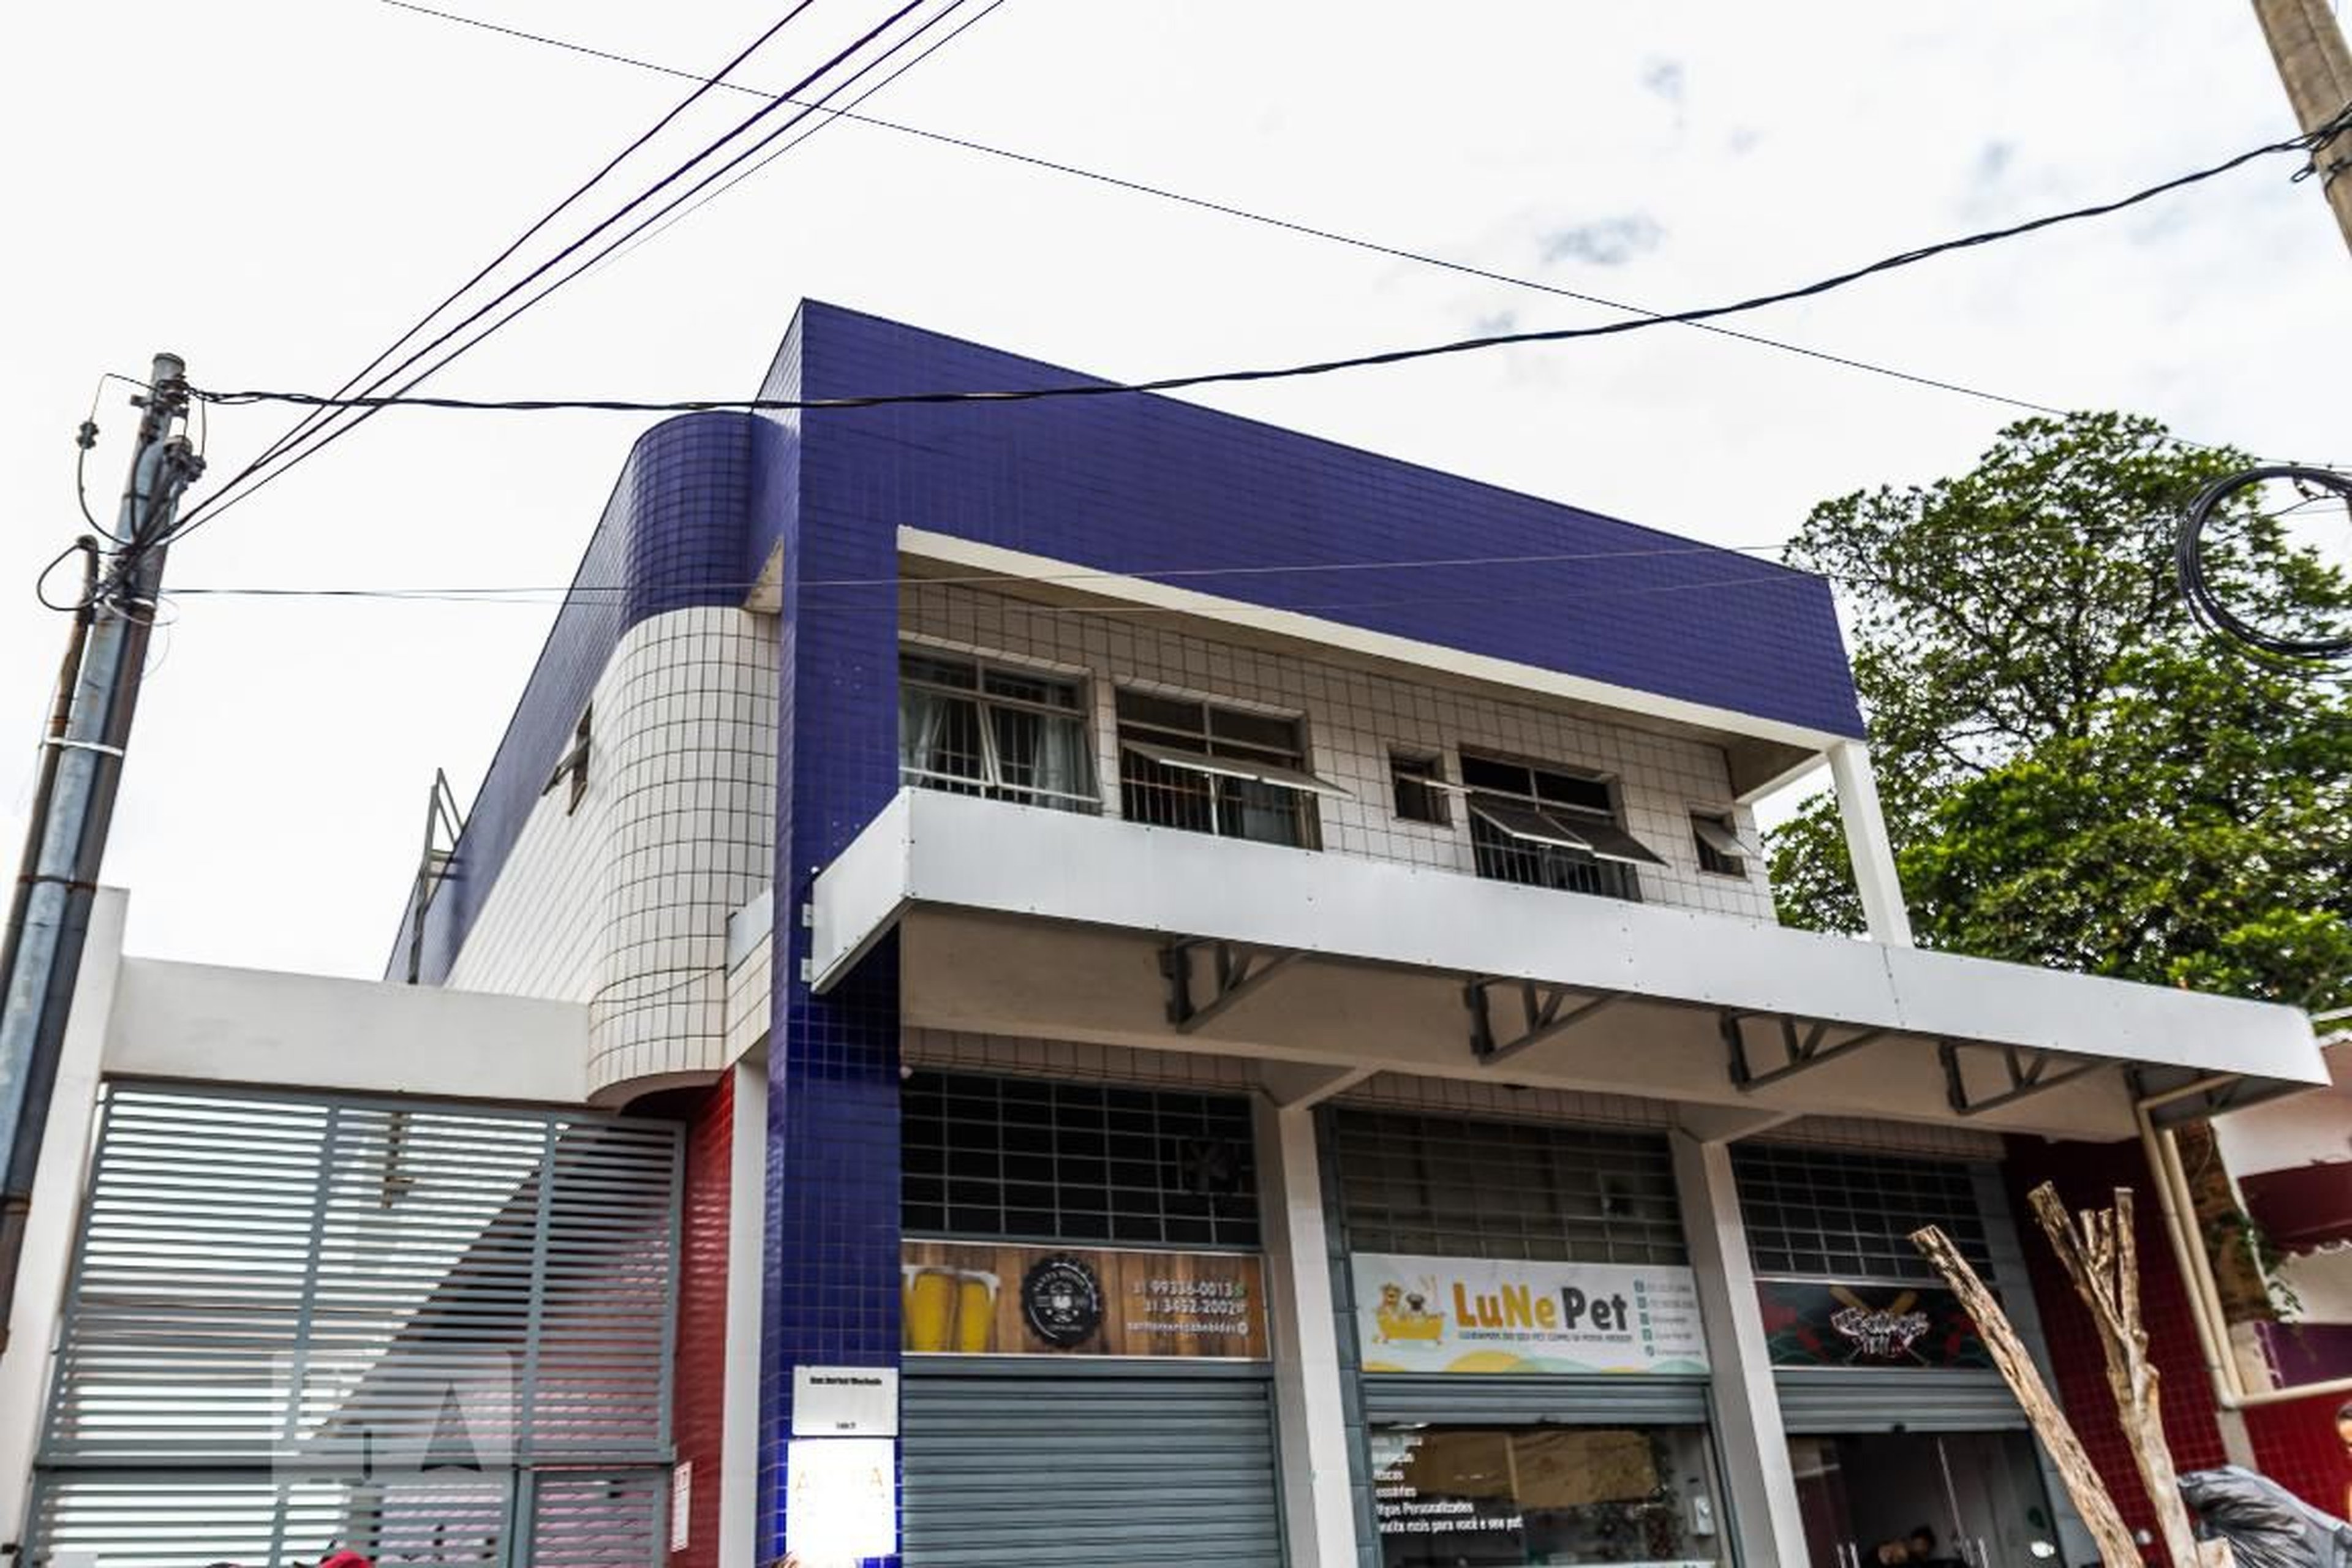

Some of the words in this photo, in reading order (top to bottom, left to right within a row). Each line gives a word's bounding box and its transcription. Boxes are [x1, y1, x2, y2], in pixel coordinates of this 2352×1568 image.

[1453, 1283, 1556, 1329] LuNe
[1561, 1286, 1627, 1331] Pet
[1431, 1520, 1453, 1534] para
[1455, 1515, 1478, 1530] você
